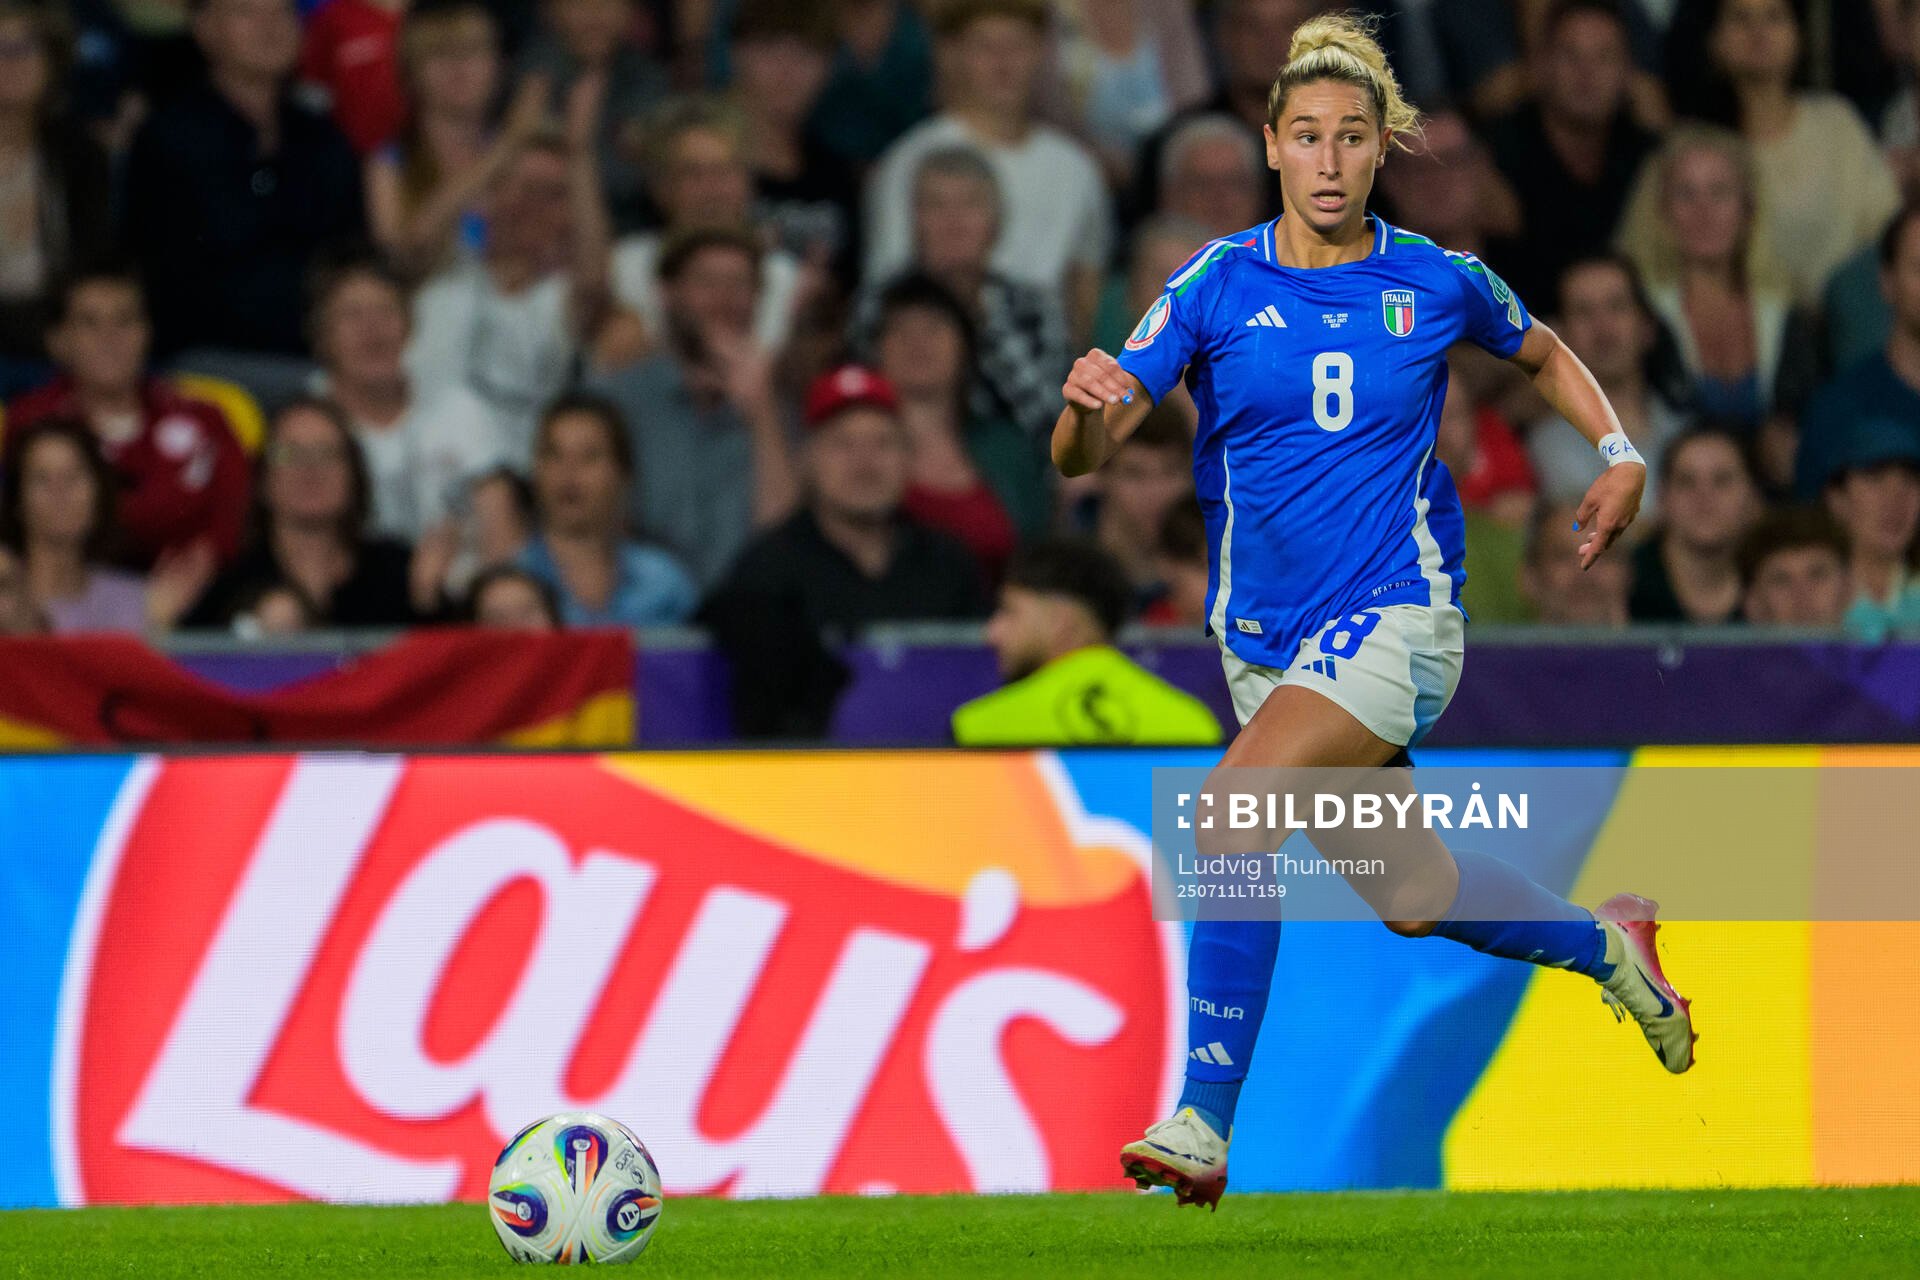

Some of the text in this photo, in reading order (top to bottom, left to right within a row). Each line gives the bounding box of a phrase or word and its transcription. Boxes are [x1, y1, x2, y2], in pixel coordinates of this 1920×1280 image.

[1385, 293, 1412, 303] ITALIA
[1312, 351, 1354, 432] 8
[1319, 612, 1382, 660] 8
[116, 754, 1125, 1201] Lay's
[1190, 996, 1245, 1020] ITALIA
